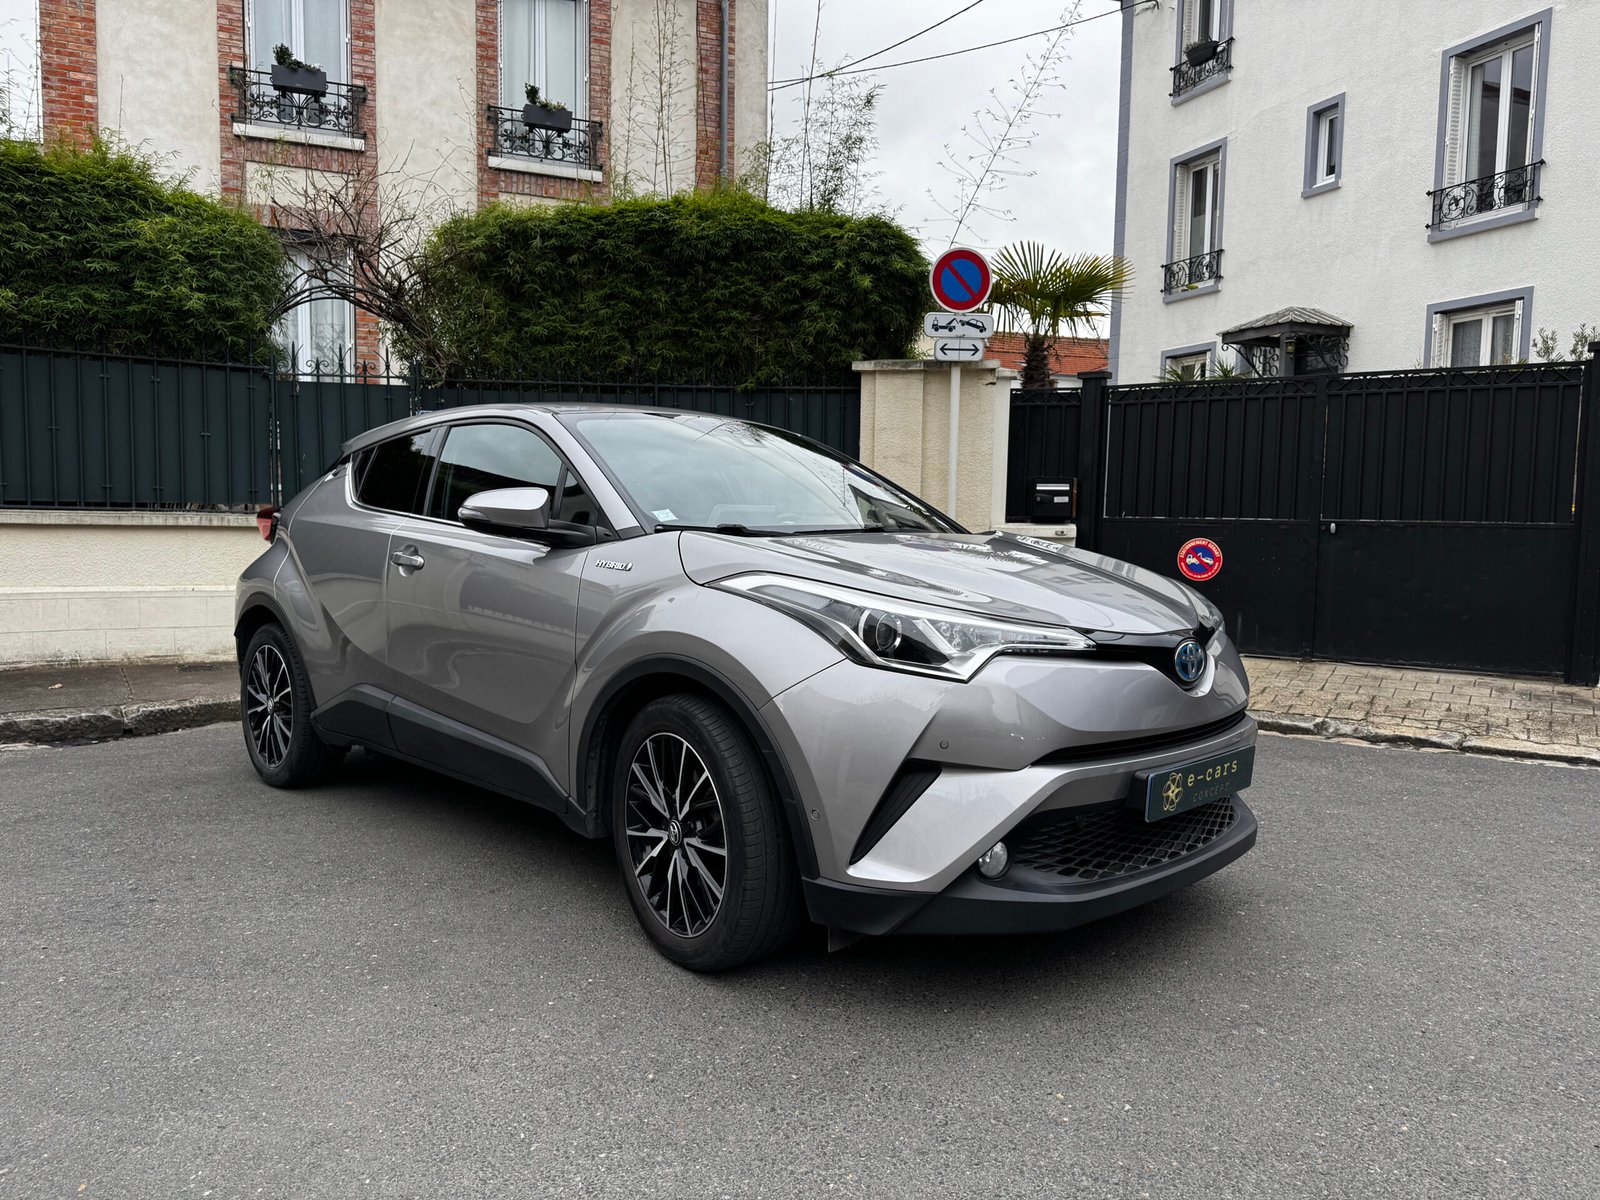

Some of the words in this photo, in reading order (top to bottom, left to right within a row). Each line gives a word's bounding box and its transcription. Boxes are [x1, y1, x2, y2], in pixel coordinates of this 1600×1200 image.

[595, 559, 626, 571] HYBRID
[1187, 760, 1238, 786] e-cars
[1193, 782, 1230, 801] CONCEPT
